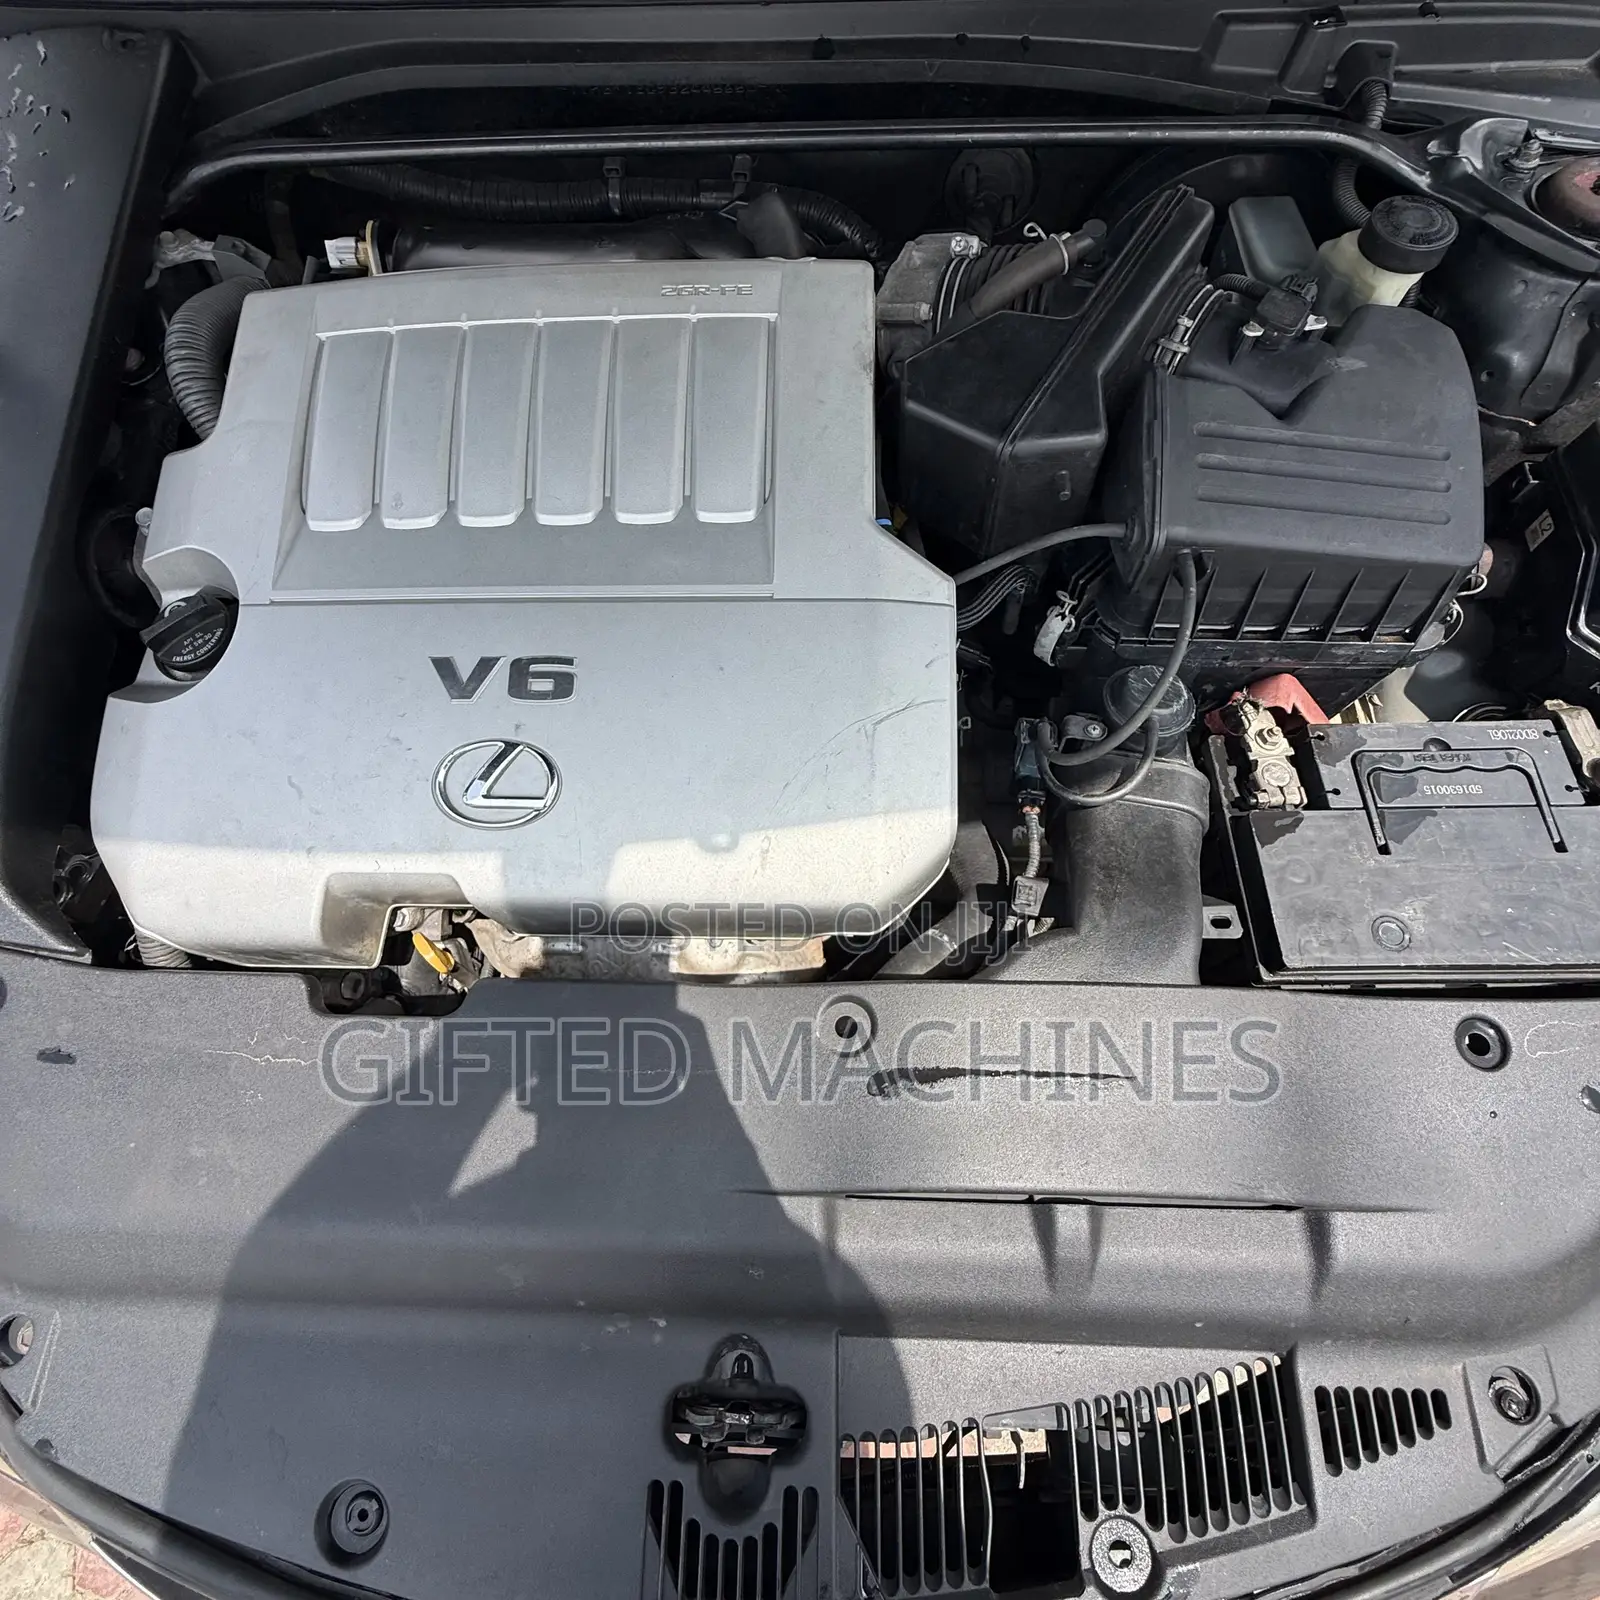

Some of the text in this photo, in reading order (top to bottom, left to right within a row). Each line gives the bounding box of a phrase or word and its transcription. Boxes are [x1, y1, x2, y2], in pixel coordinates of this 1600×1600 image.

[661, 284, 753, 297] 2GR-FE
[181, 633, 212, 655] SAE 5W-30
[172, 653, 195, 662] ENERGY
[428, 655, 578, 705] V6
[1423, 784, 1483, 796] 5D1630015
